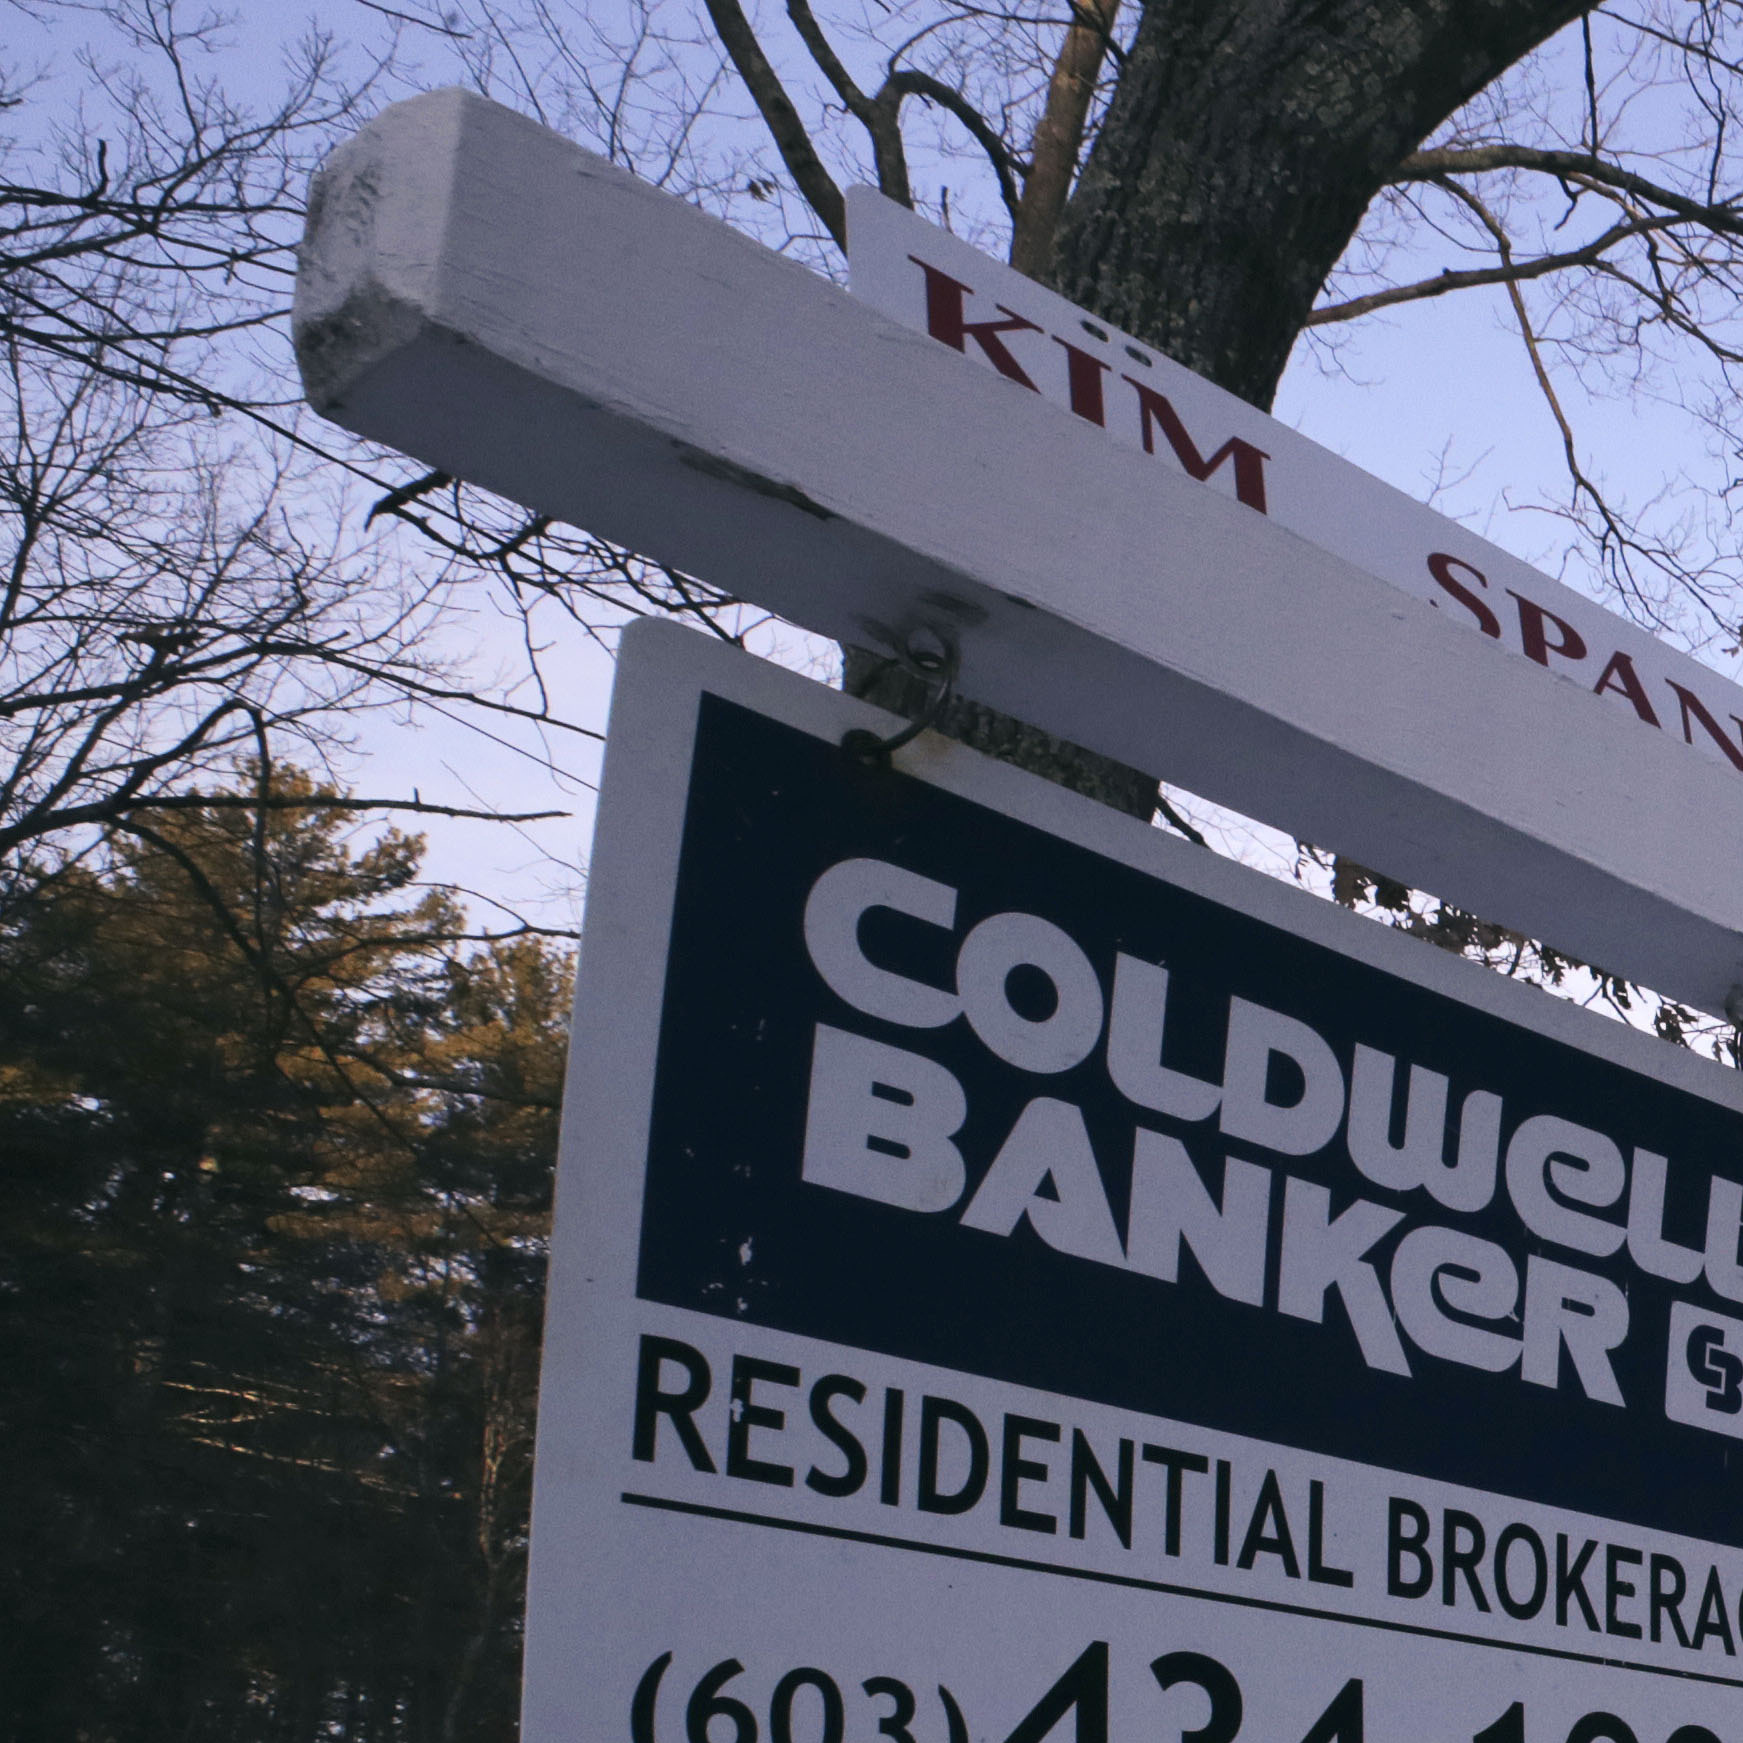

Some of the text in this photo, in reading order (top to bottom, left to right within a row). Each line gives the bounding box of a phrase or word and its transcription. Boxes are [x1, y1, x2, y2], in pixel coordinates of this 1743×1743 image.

[907, 253, 1271, 516] KIM
[801, 1022, 1630, 1409] BANKER
[632, 1333, 1354, 1589] RESIDENTIAL
